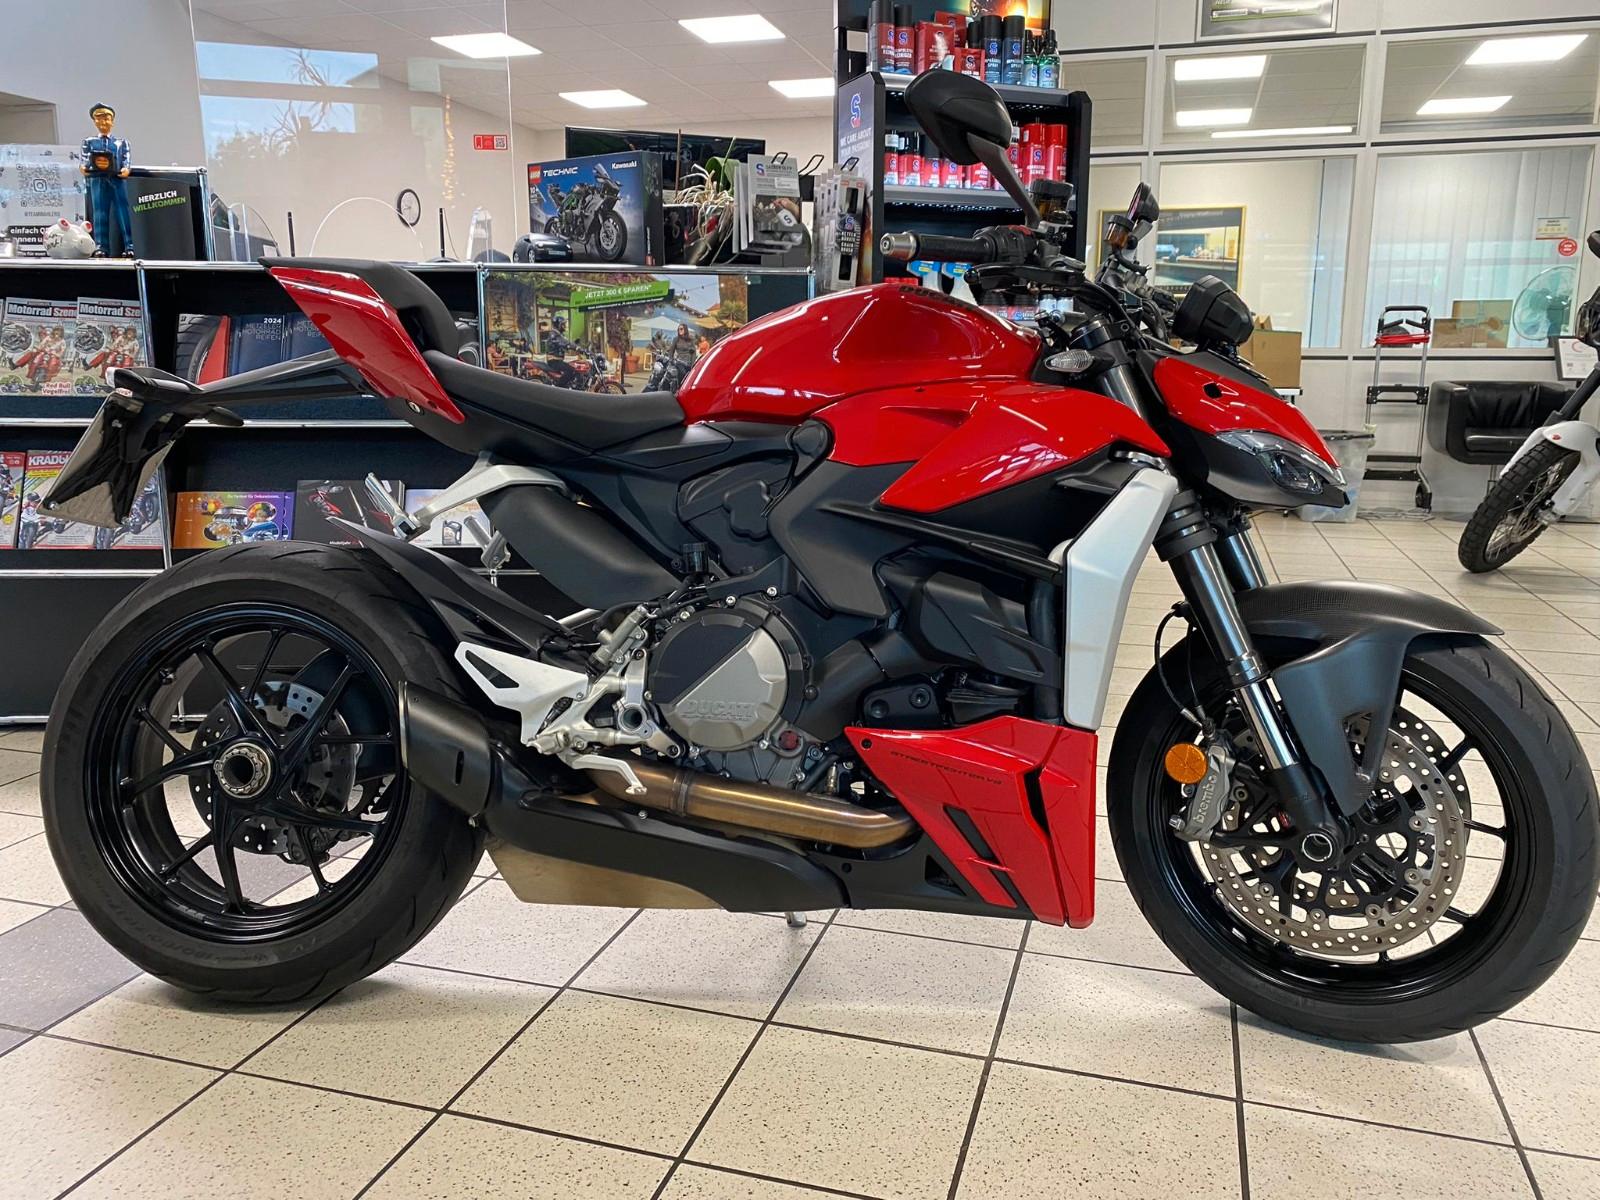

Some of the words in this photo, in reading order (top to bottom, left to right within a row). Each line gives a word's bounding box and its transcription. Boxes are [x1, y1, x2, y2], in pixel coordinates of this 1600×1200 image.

[543, 166, 579, 177] TECHNIC
[611, 160, 637, 170] Kawasaki
[132, 196, 186, 213] WILLKOMMEN
[138, 190, 177, 204] HERZLICH
[585, 290, 605, 299] JETZT
[606, 288, 617, 296] 300
[8, 302, 52, 316] Motorrad
[53, 307, 77, 318] Szen
[80, 302, 123, 316] Motorrad
[682, 699, 754, 717] DUCATI
[890, 751, 985, 780] STREETFIGHTER
[986, 776, 1002, 785] V2
[1192, 774, 1217, 824] brembo
